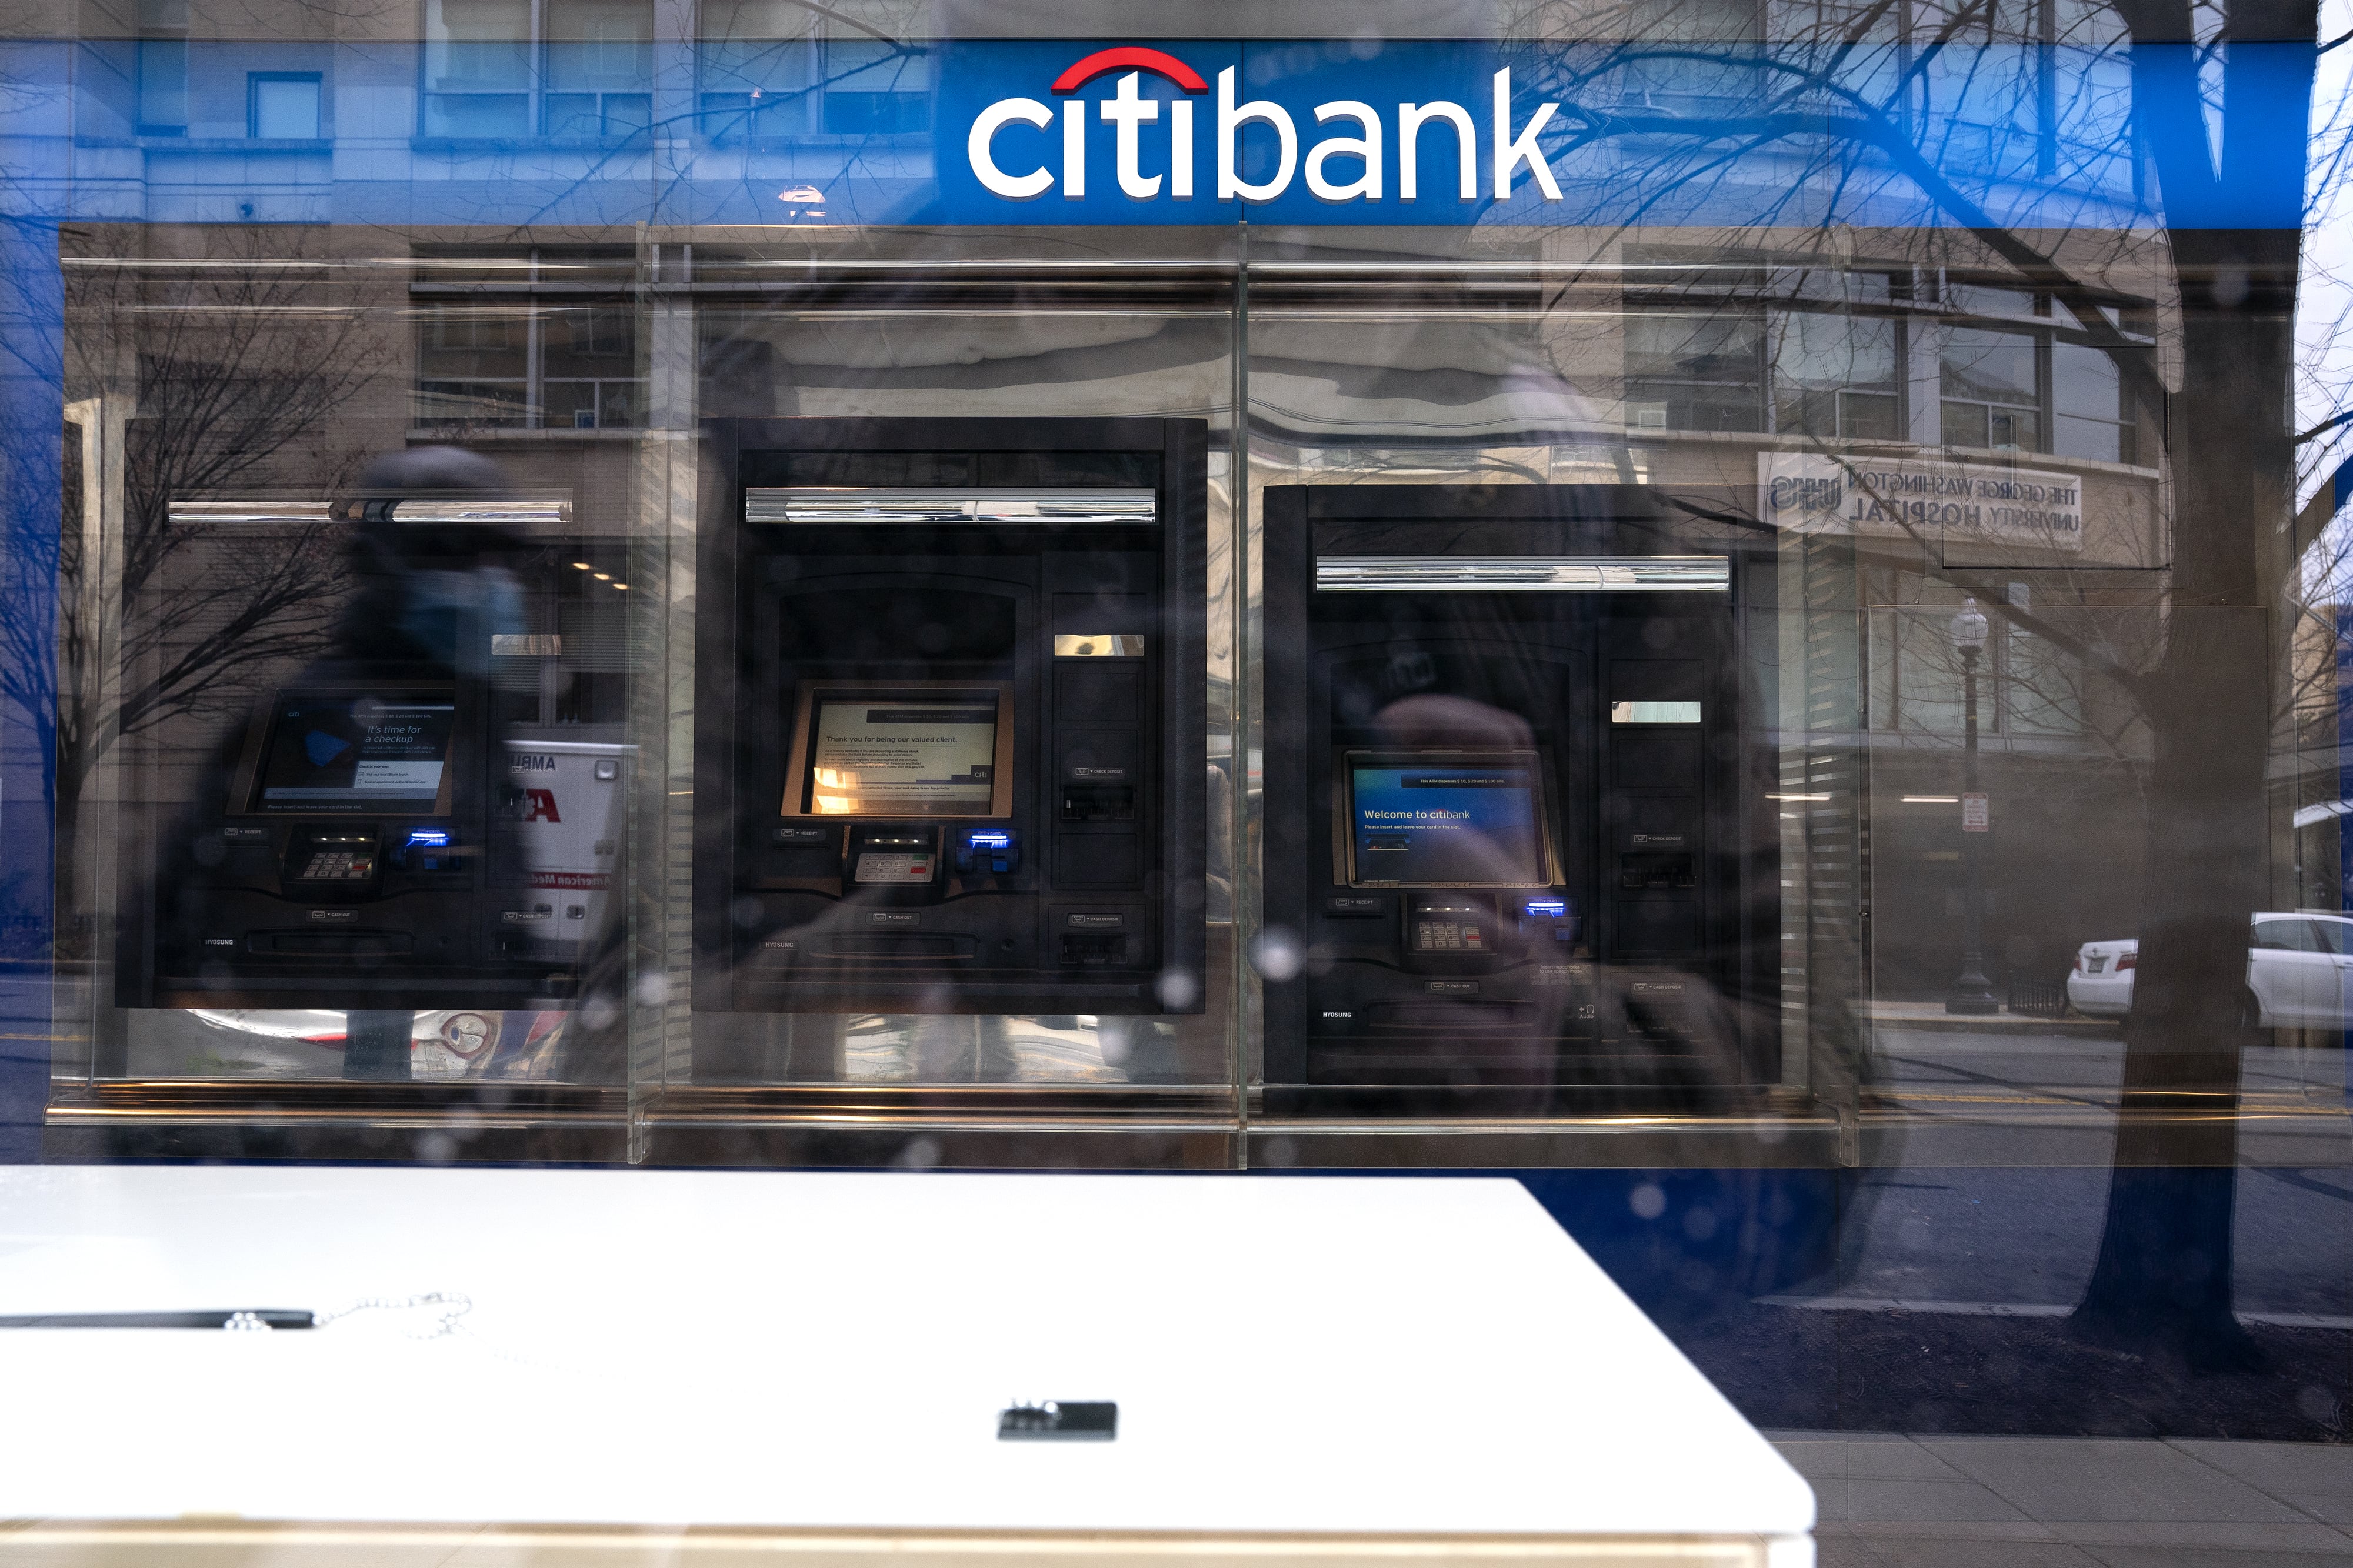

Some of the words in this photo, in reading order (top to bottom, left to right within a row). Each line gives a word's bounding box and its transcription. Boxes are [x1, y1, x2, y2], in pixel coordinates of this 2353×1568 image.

[968, 65, 1564, 202] citibank
[368, 726, 381, 734] It's
[384, 726, 405, 734] time
[408, 726, 422, 734] for
[374, 735, 413, 745] checkup
[876, 736, 895, 745] being
[1364, 810, 1412, 819] Welcome
[1416, 810, 1427, 819] to
[1429, 810, 1471, 819] citibank
